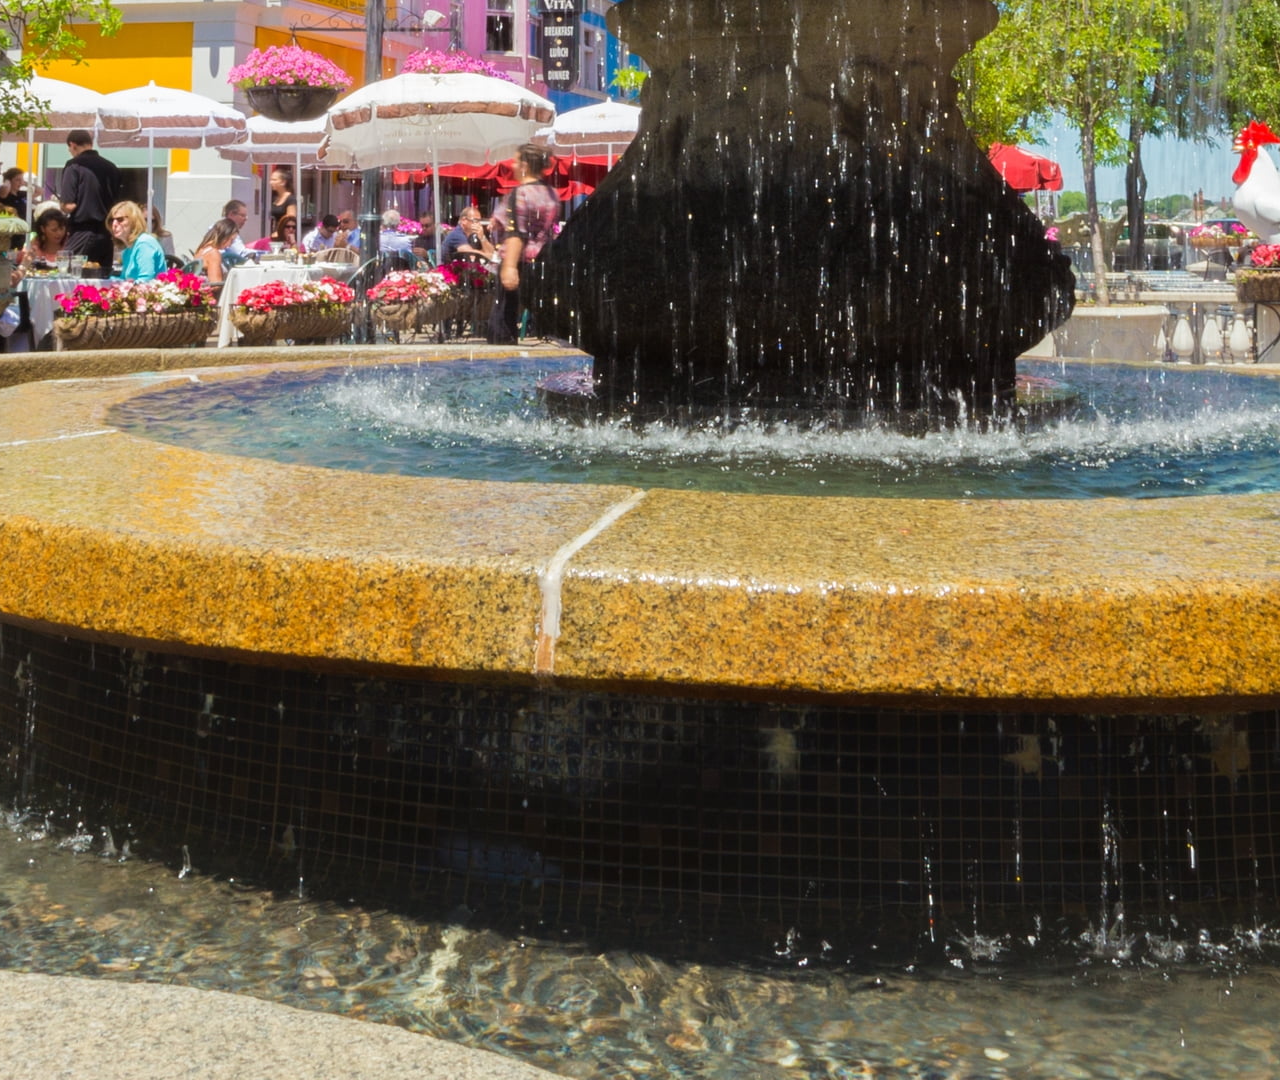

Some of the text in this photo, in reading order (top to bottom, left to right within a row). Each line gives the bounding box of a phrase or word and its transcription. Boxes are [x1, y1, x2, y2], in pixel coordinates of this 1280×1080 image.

[544, 0, 574, 9] VITA
[544, 26, 574, 36] BREAKFAST
[549, 47, 568, 58] LUNCH
[548, 70, 570, 80] DINNER
